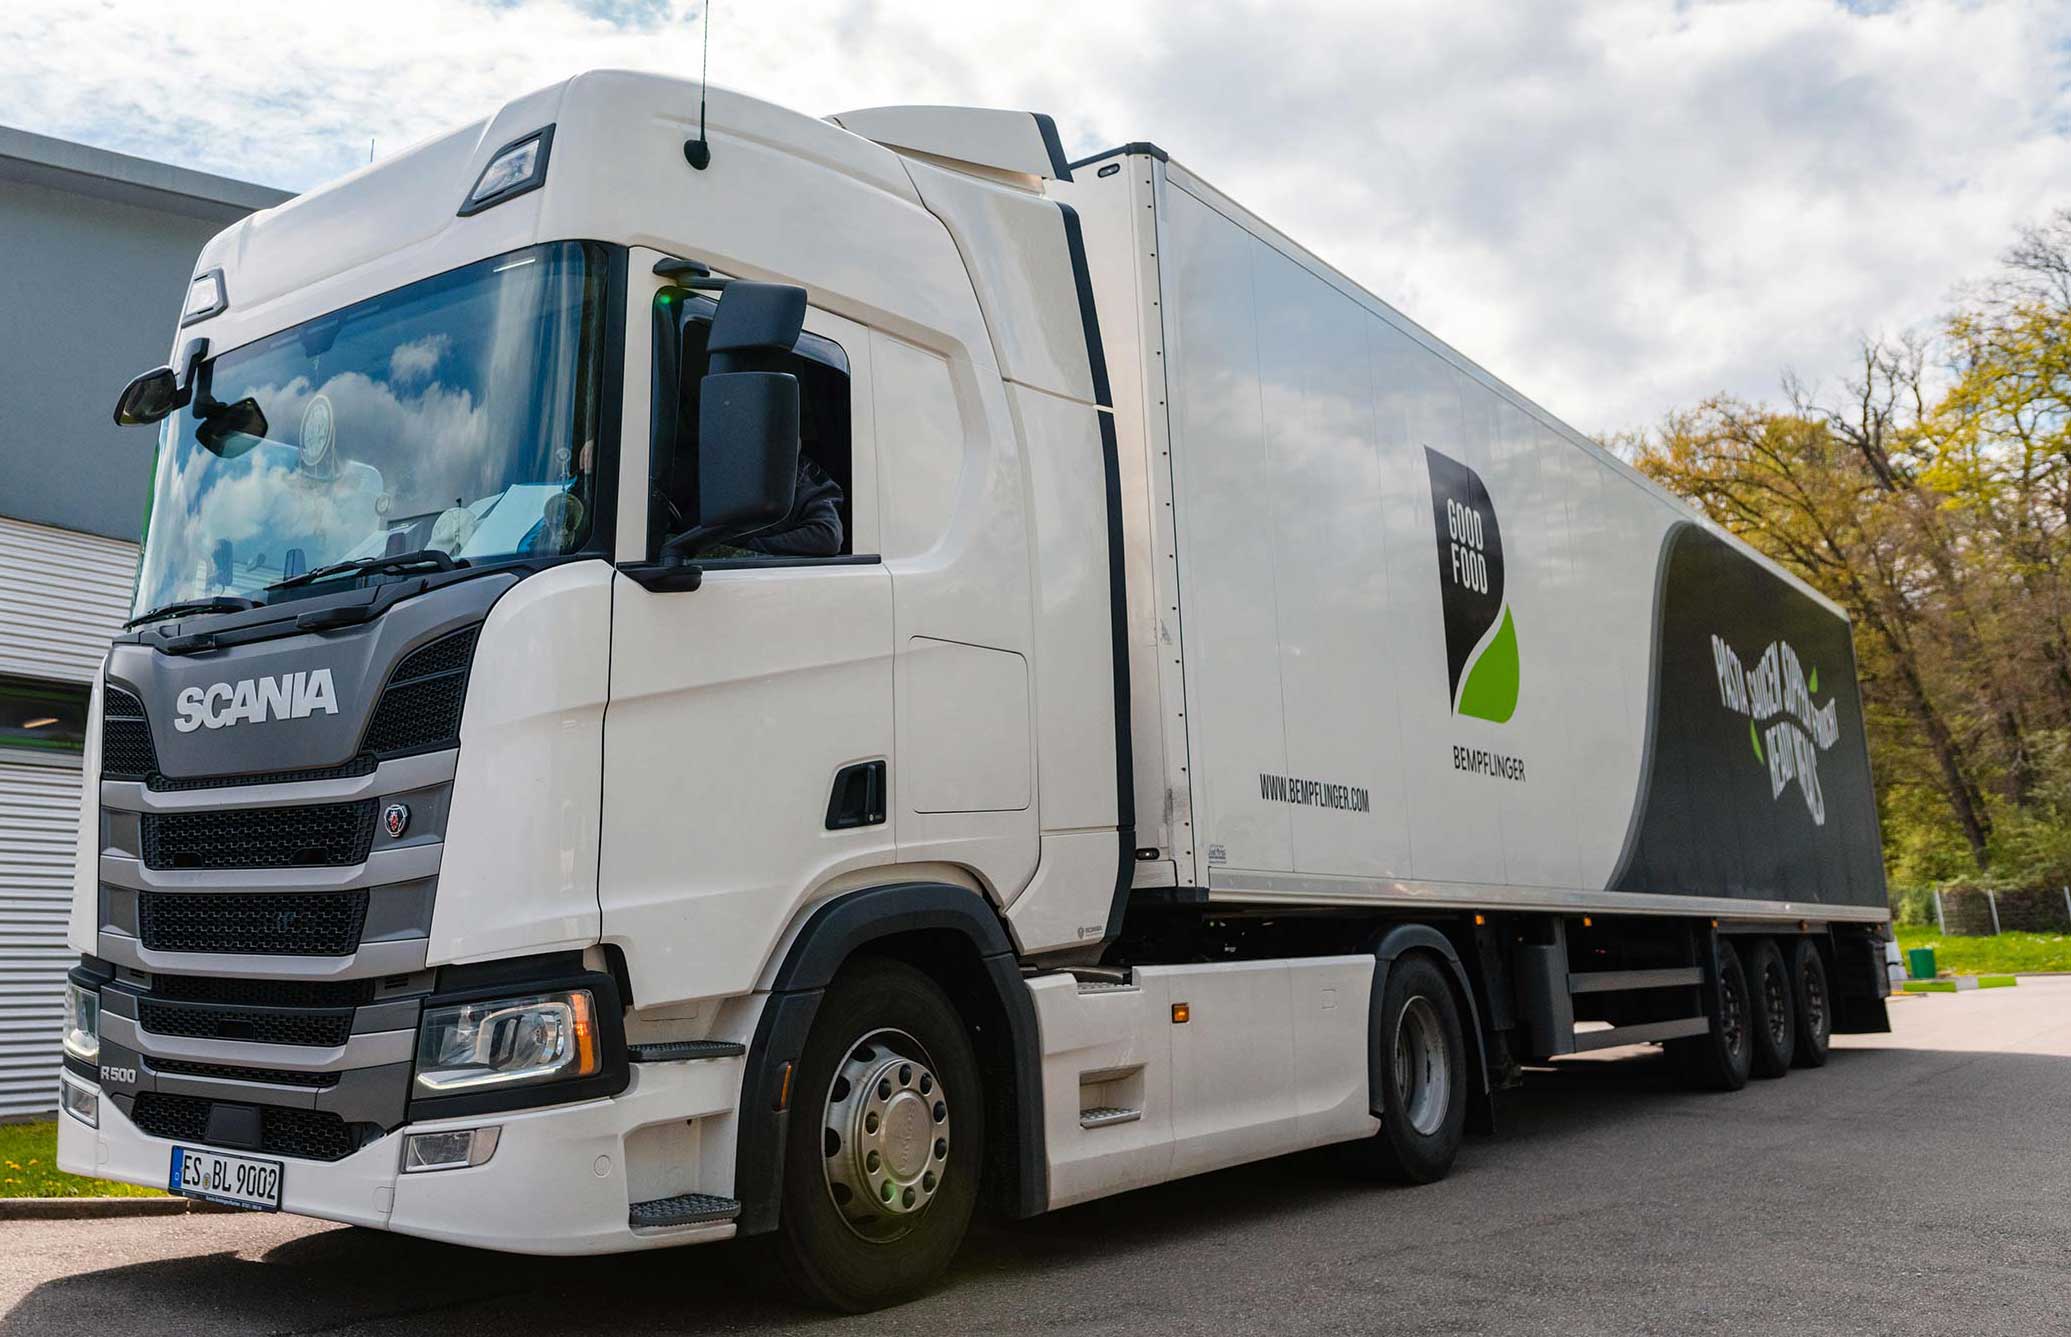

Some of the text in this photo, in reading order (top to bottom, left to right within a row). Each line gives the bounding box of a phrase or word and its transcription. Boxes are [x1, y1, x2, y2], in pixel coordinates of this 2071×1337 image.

[1447, 497, 1484, 551] GOOD
[1451, 542, 1488, 595] FOOD
[1711, 634, 1750, 716] PASTA
[174, 668, 339, 733] SCANIA
[1452, 745, 1526, 784] BEMPFLINGER
[1260, 772, 1370, 814] WWW.BEMPFLINGER.COM
[100, 1065, 137, 1084] R500
[182, 1154, 277, 1200] ES BL 9002
